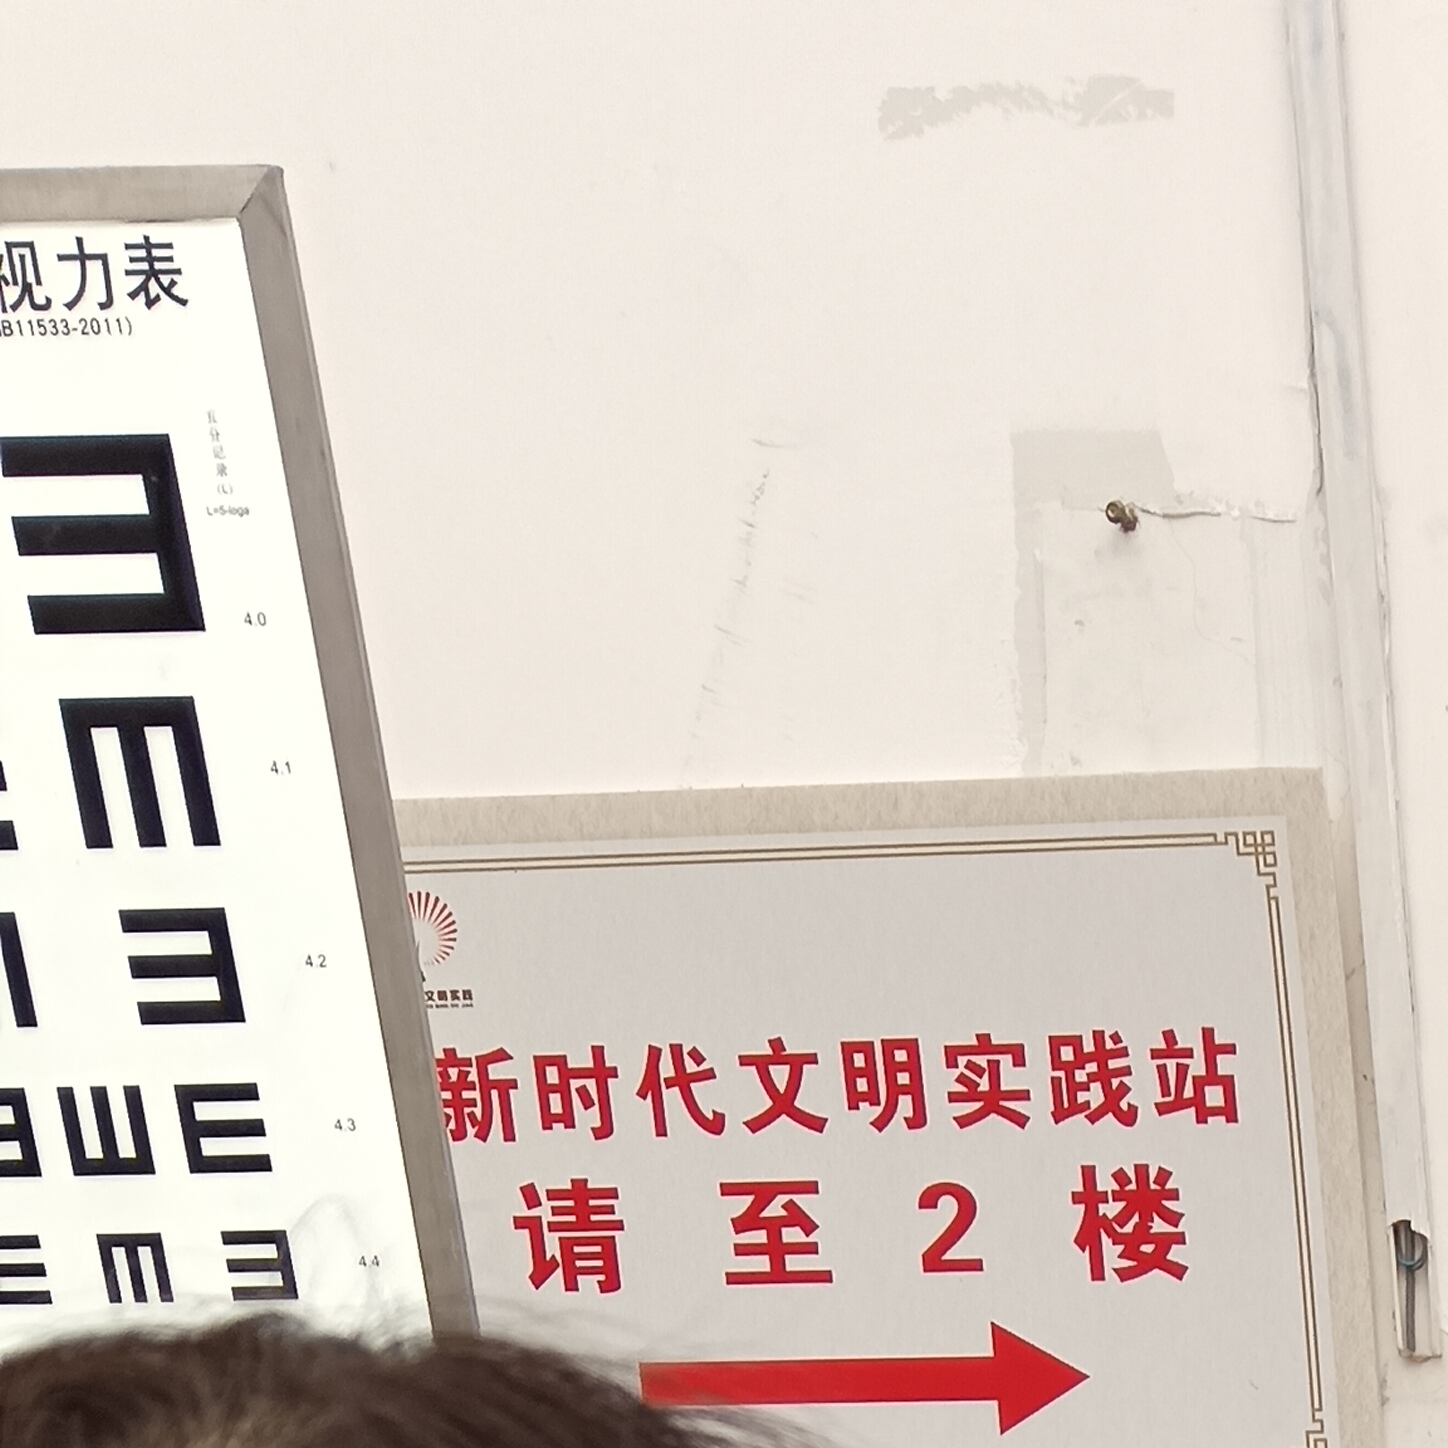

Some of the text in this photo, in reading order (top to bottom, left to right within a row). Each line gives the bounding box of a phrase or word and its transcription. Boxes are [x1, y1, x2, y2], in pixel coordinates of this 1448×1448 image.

[0, 235, 188, 313] 视力表
[0, 317, 132, 337] B11533-2011)
[244, 612, 267, 626] 4.0
[270, 760, 291, 775] 4.1
[304, 954, 327, 968] 4.2
[437, 1028, 1237, 1142] 新时代文明实践站
[334, 1118, 356, 1132] 4.3
[358, 1255, 380, 1268] 4.4
